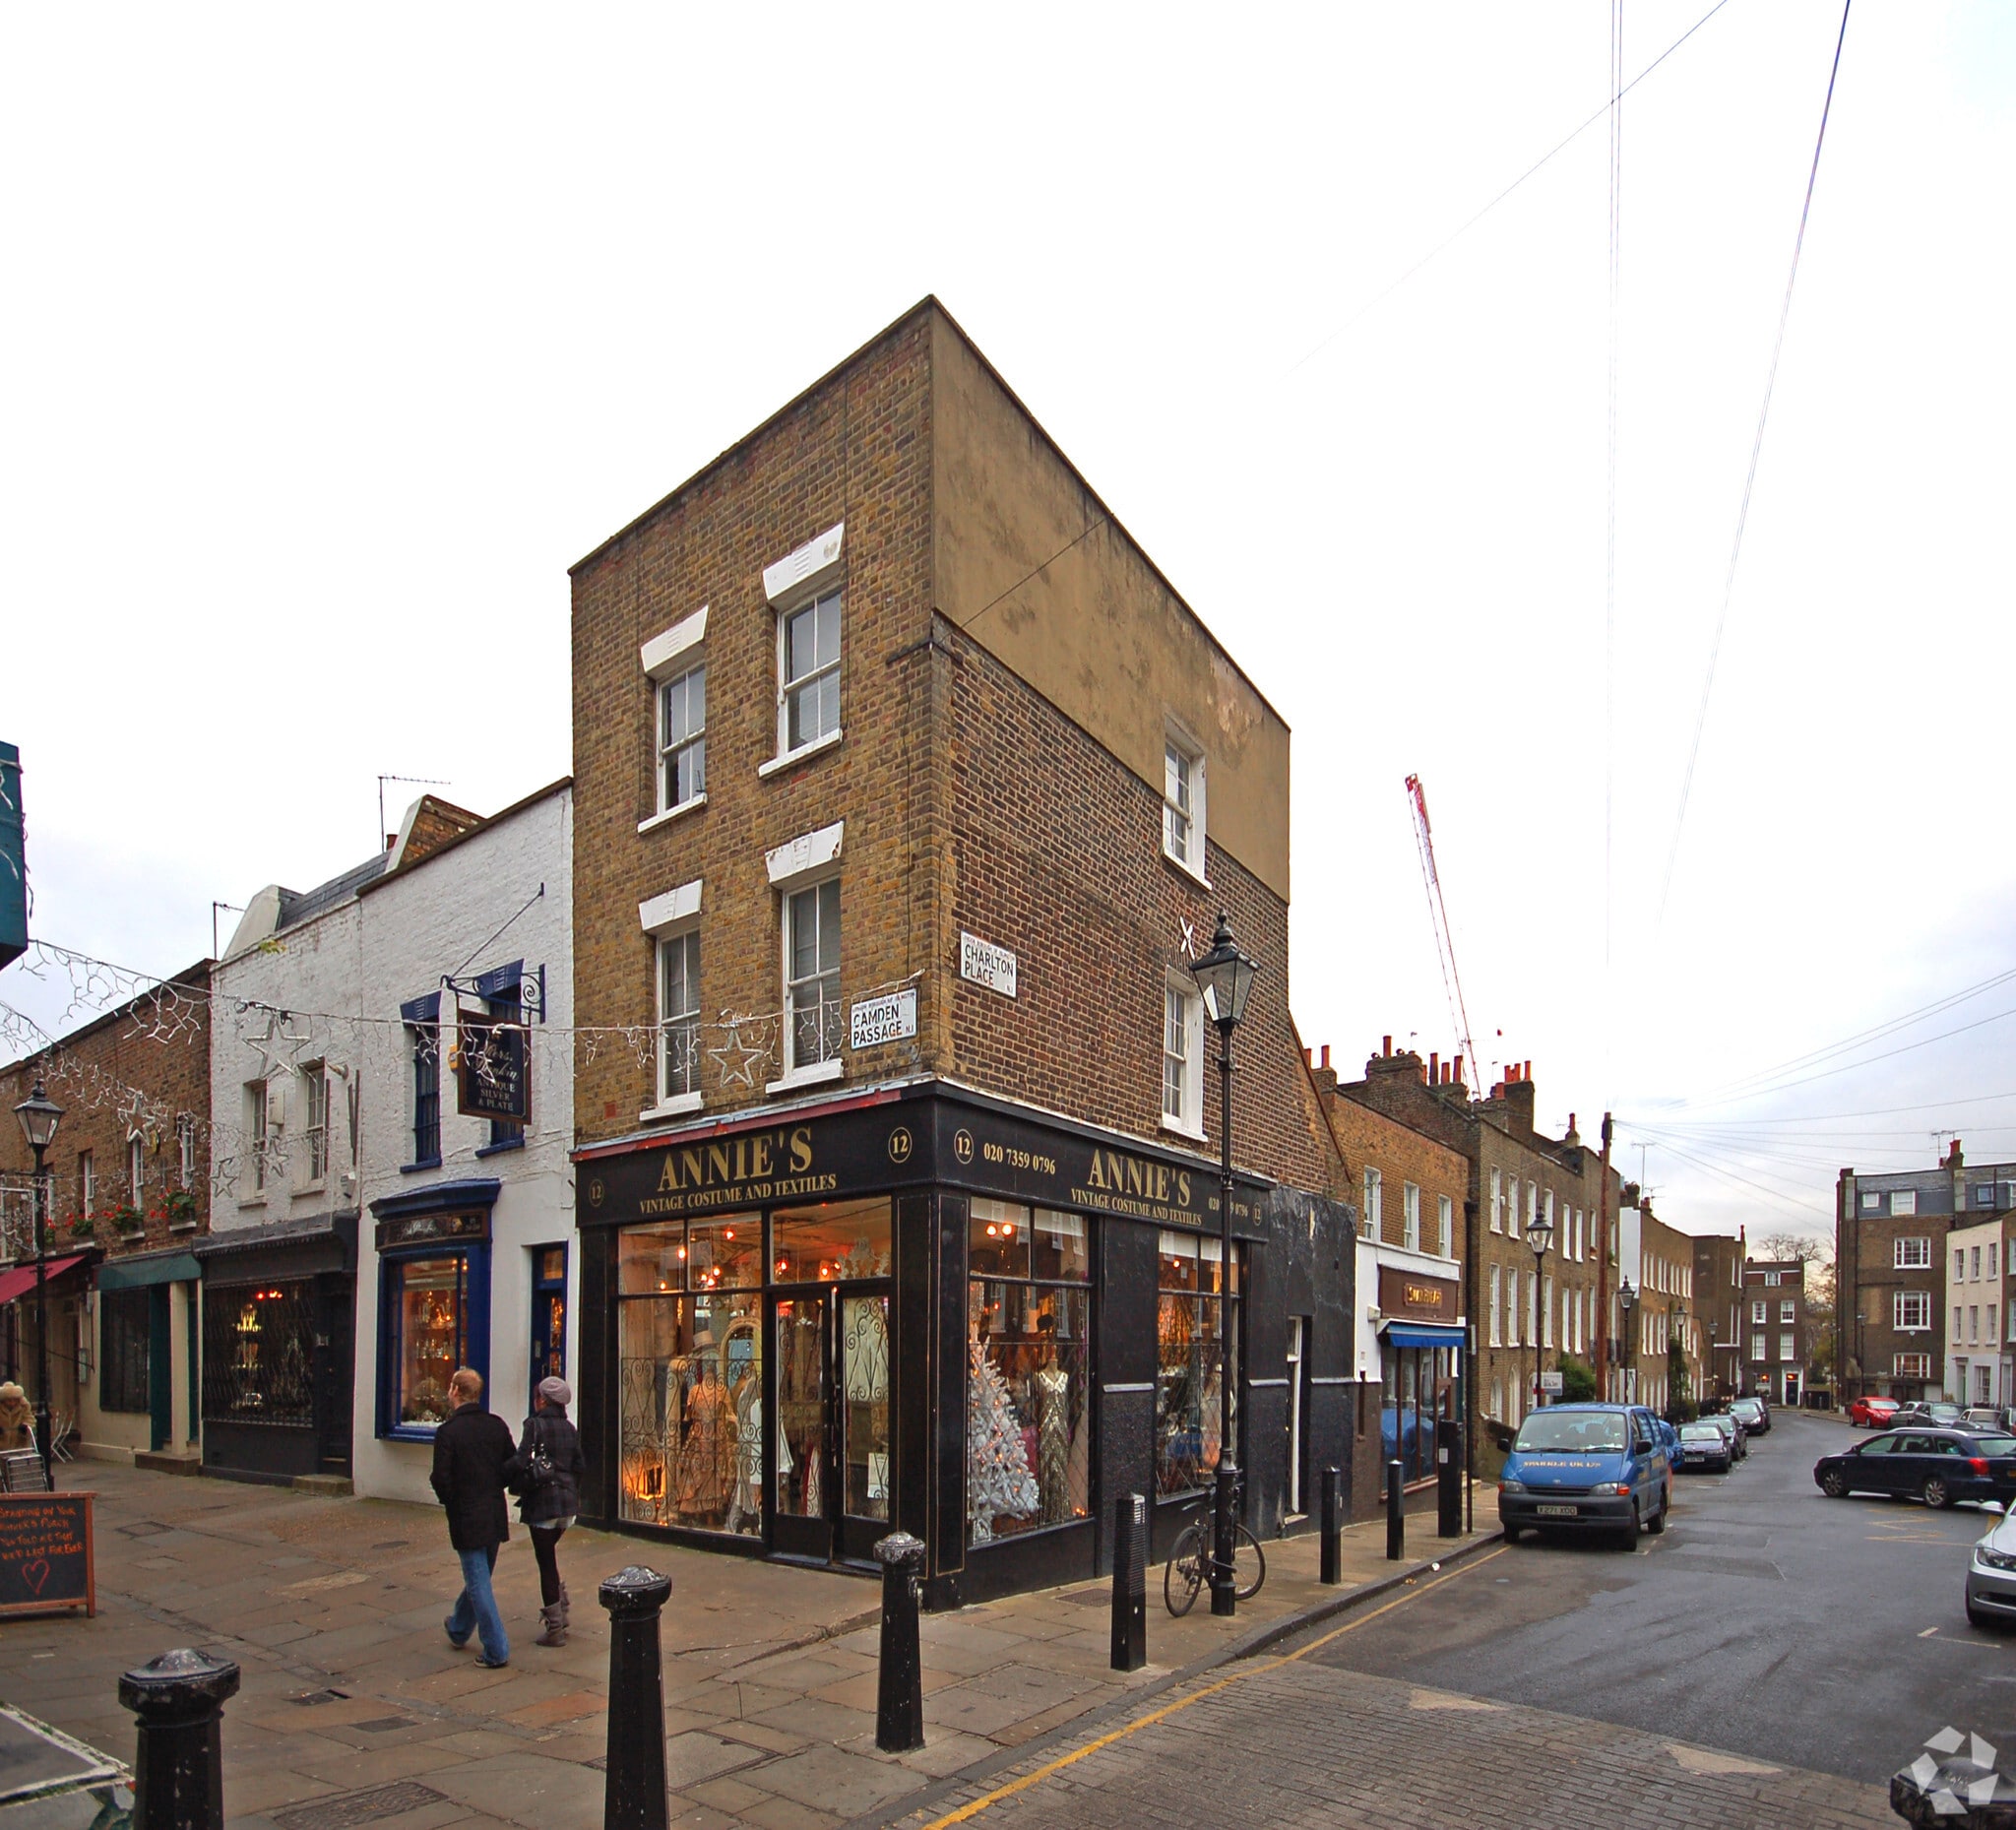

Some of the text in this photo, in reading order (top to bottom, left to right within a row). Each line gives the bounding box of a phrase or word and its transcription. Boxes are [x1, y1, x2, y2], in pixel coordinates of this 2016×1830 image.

[965, 944, 1014, 978] CHARLTON
[965, 960, 993, 985] PLACE
[853, 1003, 900, 1028] CAMDEN
[853, 1020, 903, 1045] PASSAGE
[480, 1089, 510, 1102] SILVER
[487, 1099, 514, 1111] PLATE
[892, 1135, 909, 1154] 12
[957, 1136, 972, 1156] 12
[658, 1126, 812, 1191] ANNIE'S
[984, 1142, 1056, 1175] 020 7359 0796
[1087, 1149, 1191, 1207] ANNIE'S
[592, 1185, 601, 1199] 12
[640, 1173, 837, 1214] VINTAGE COSTUME AND TEXTILES
[1209, 1196, 1220, 1212] 020
[1071, 1188, 1202, 1228] VINTAGE COSTUME AND TEXTILES
